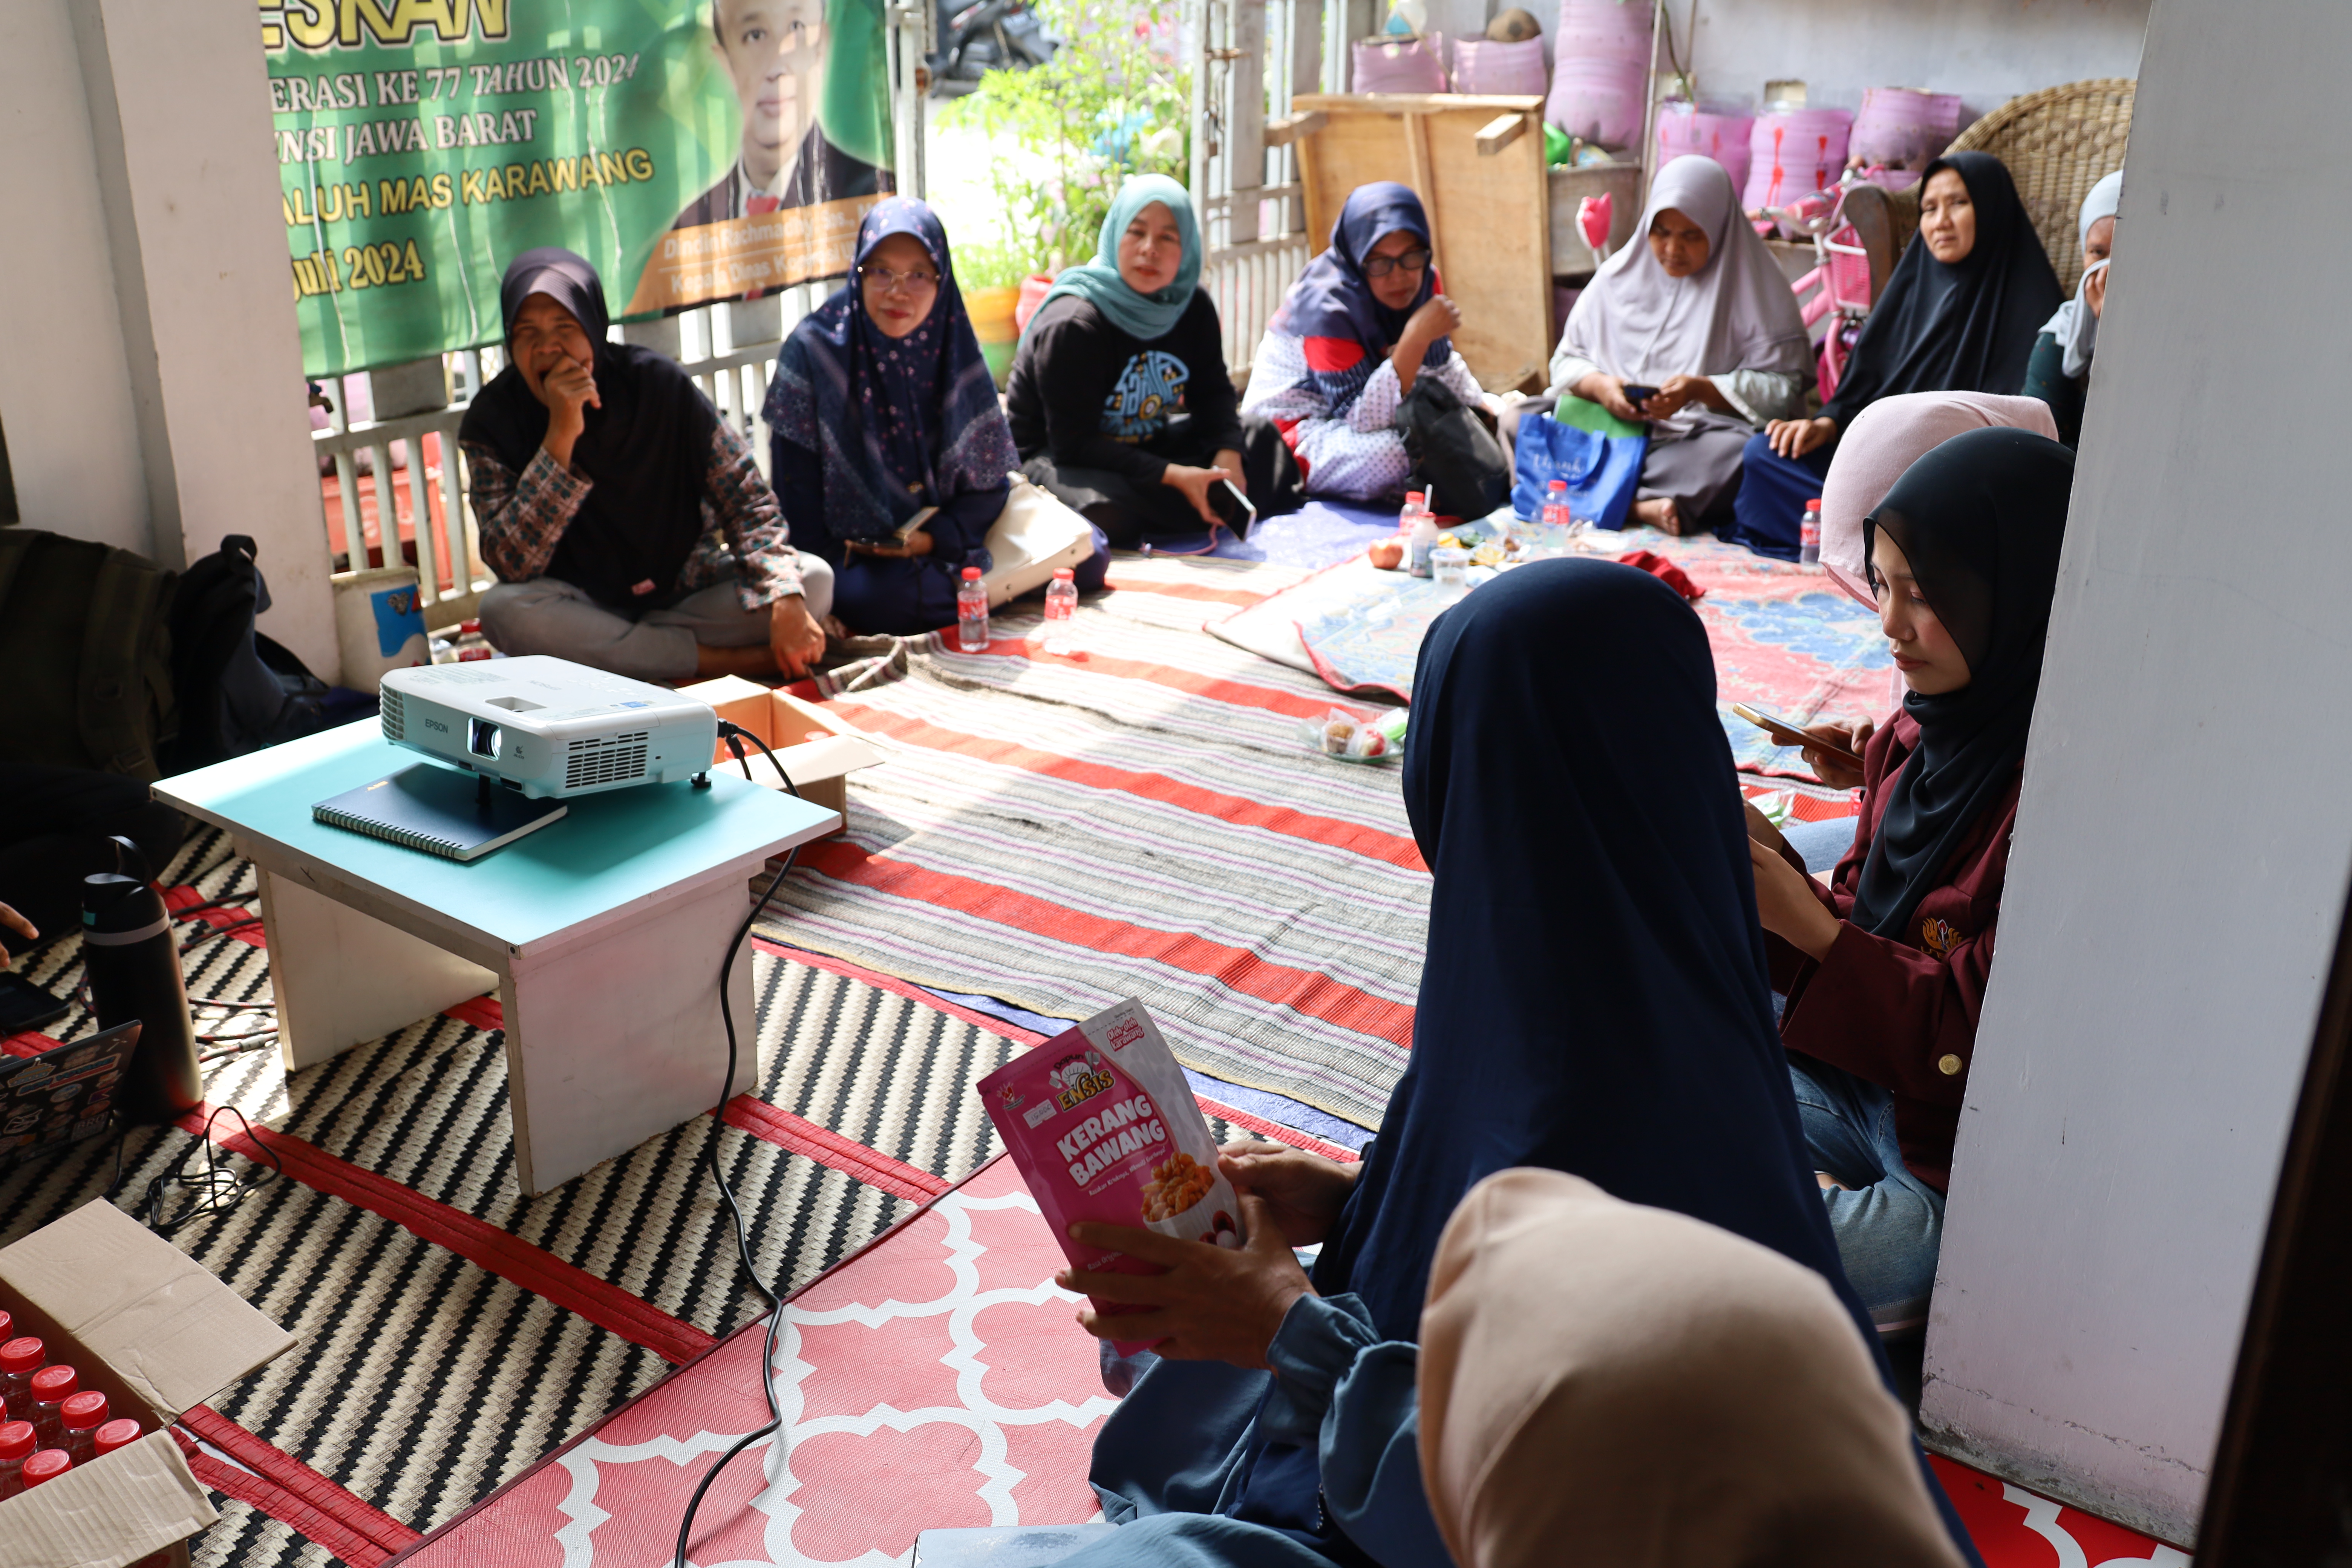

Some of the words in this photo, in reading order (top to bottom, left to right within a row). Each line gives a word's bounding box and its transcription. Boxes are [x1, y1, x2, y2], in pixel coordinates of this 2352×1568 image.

[374, 71, 420, 105] KE
[426, 67, 462, 101] 77
[469, 57, 568, 96] TAHUN
[575, 53, 640, 87] 2024
[344, 118, 429, 165] JAWA
[434, 109, 537, 149] BARAT
[380, 173, 453, 216] MAS
[461, 148, 654, 204] KARAWANG
[344, 238, 426, 289] 2024
[729, 261, 771, 283] Dinas
[425, 719, 448, 733] EPSON
[1057, 1070, 1115, 1111] ENSIS
[1057, 1095, 1152, 1162] KERANG
[1069, 1119, 1165, 1186] BAWANG
